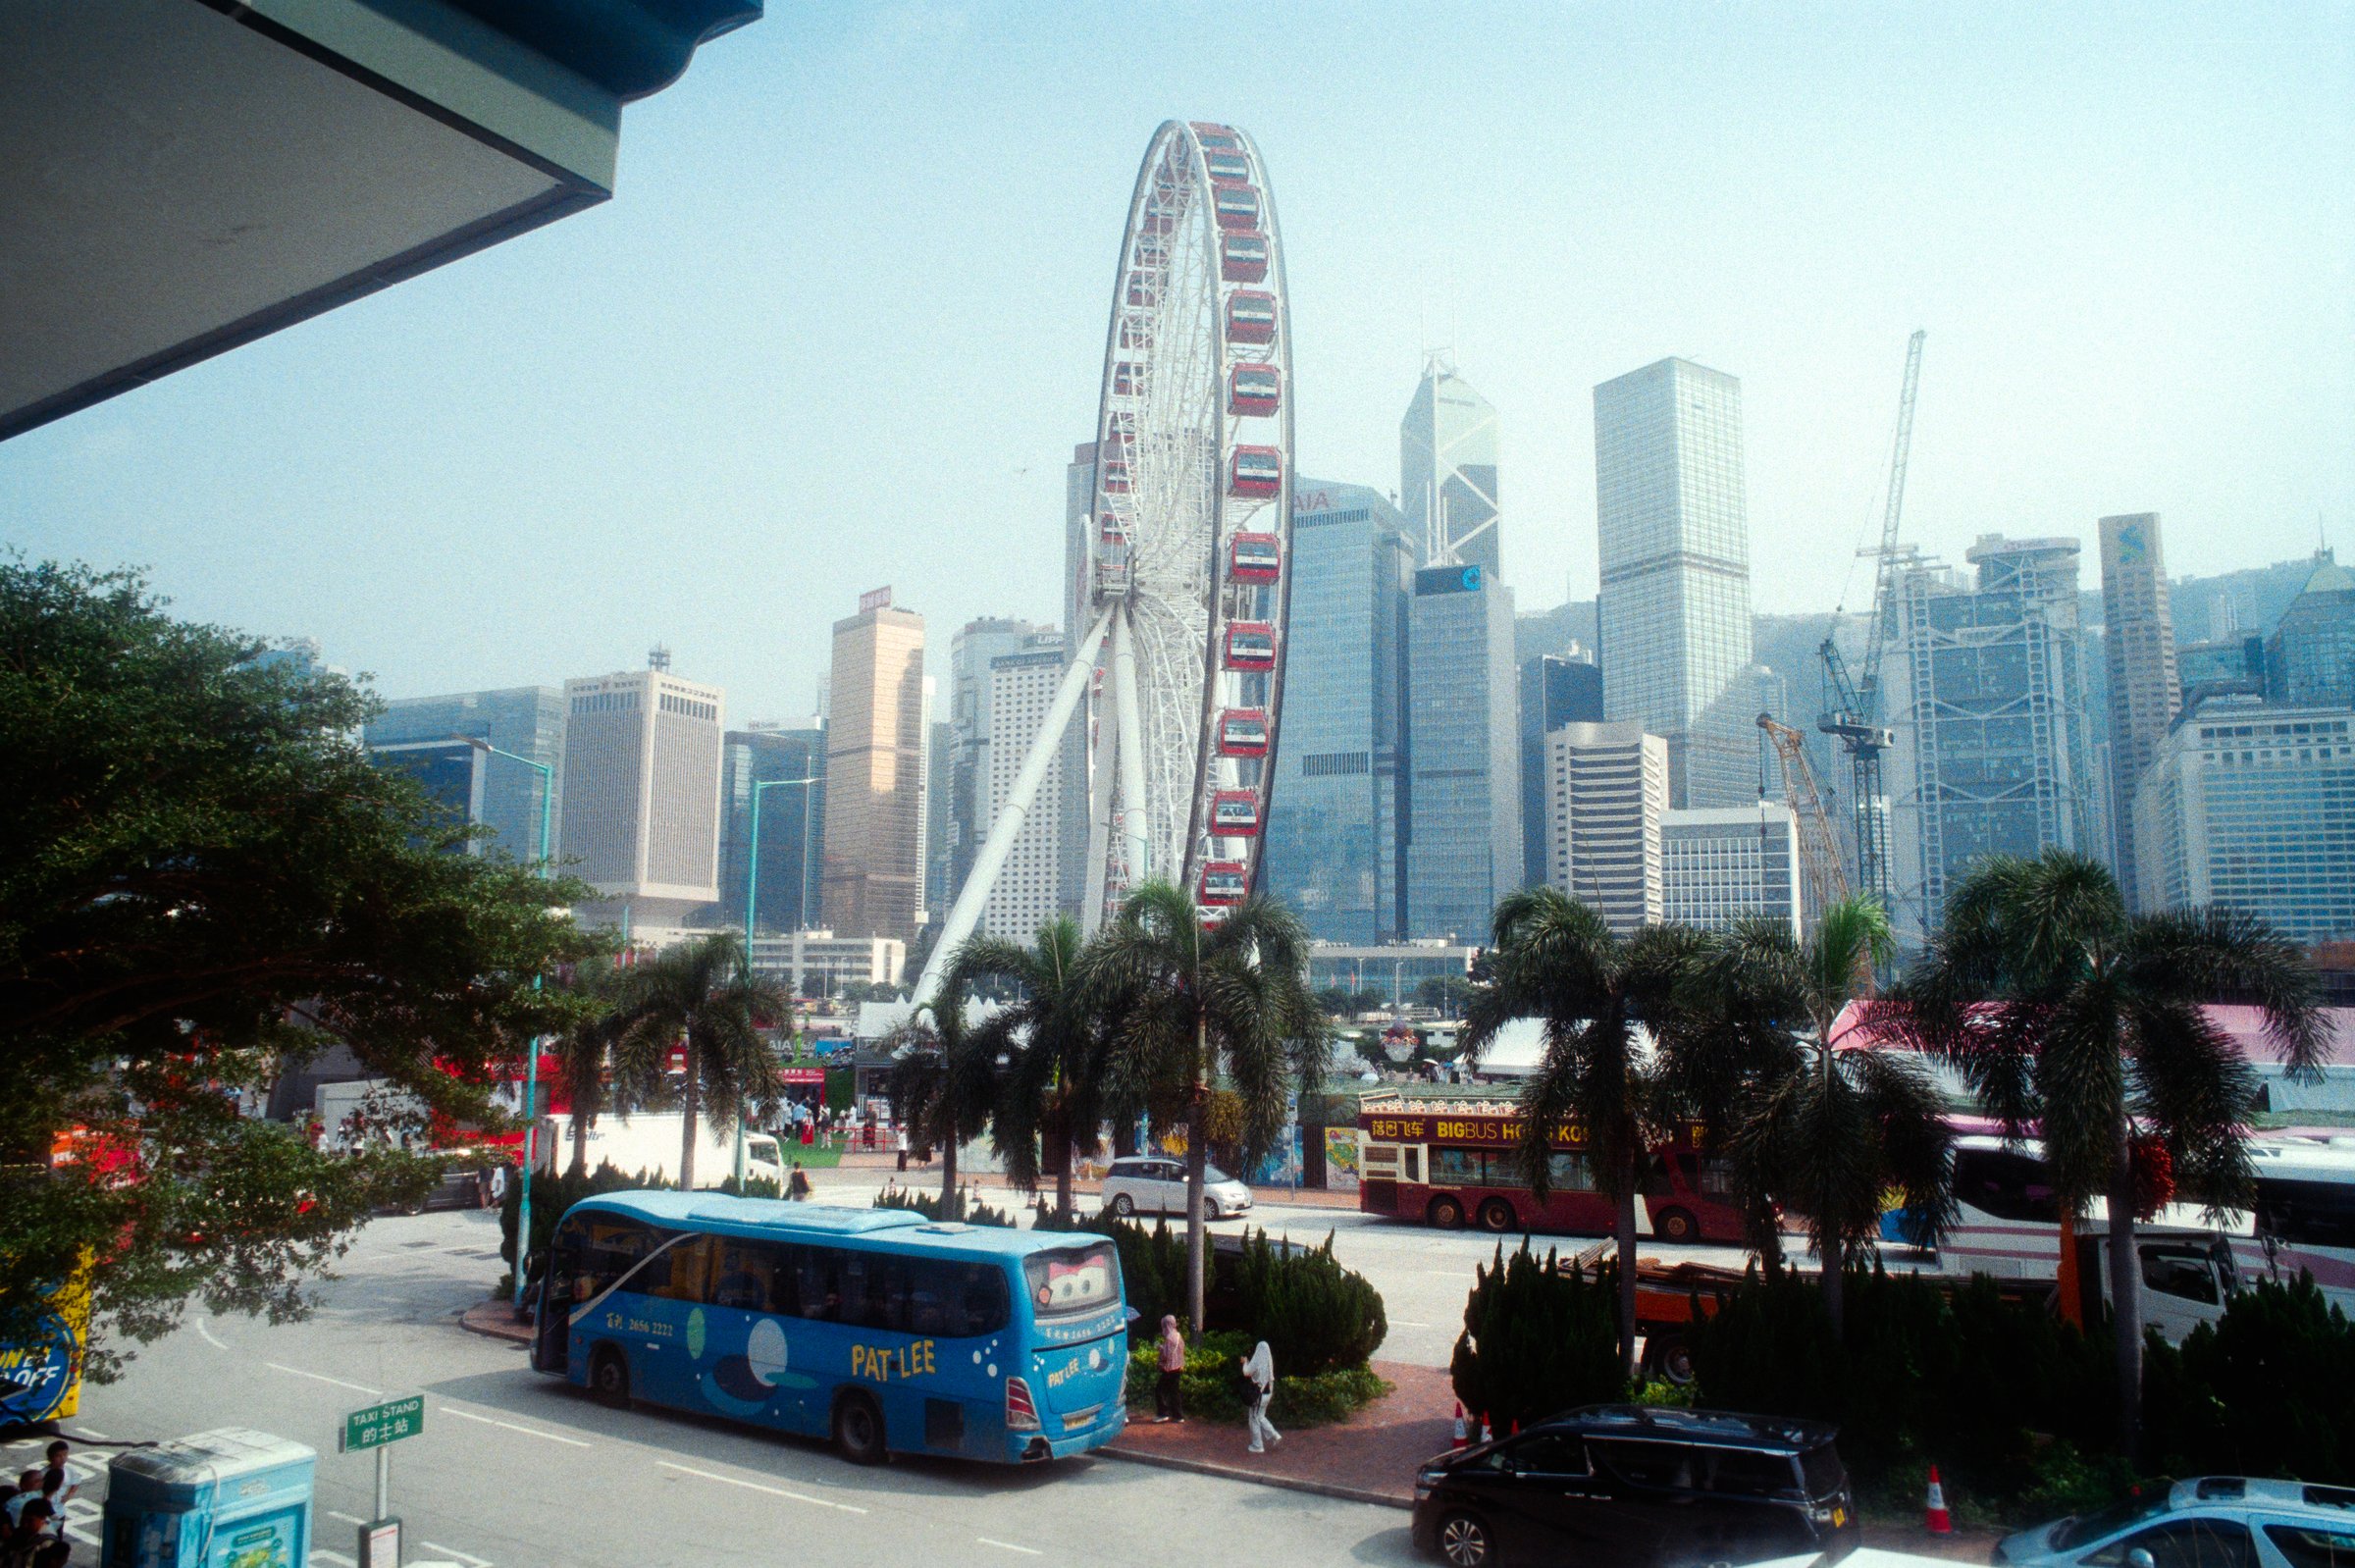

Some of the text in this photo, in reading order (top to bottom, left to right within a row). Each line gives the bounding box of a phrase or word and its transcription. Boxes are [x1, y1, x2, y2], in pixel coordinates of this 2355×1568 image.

[768, 1039, 792, 1051] AIA
[629, 1318, 650, 1333] 2656
[652, 1322, 673, 1336] 2222
[851, 1338, 936, 1382] PAT LEE
[1048, 1357, 1079, 1387] PAT LEE
[14, 1366, 61, 1386] OFF
[353, 1400, 419, 1426] TAXI STAND
[362, 1418, 408, 1443] 的士站
